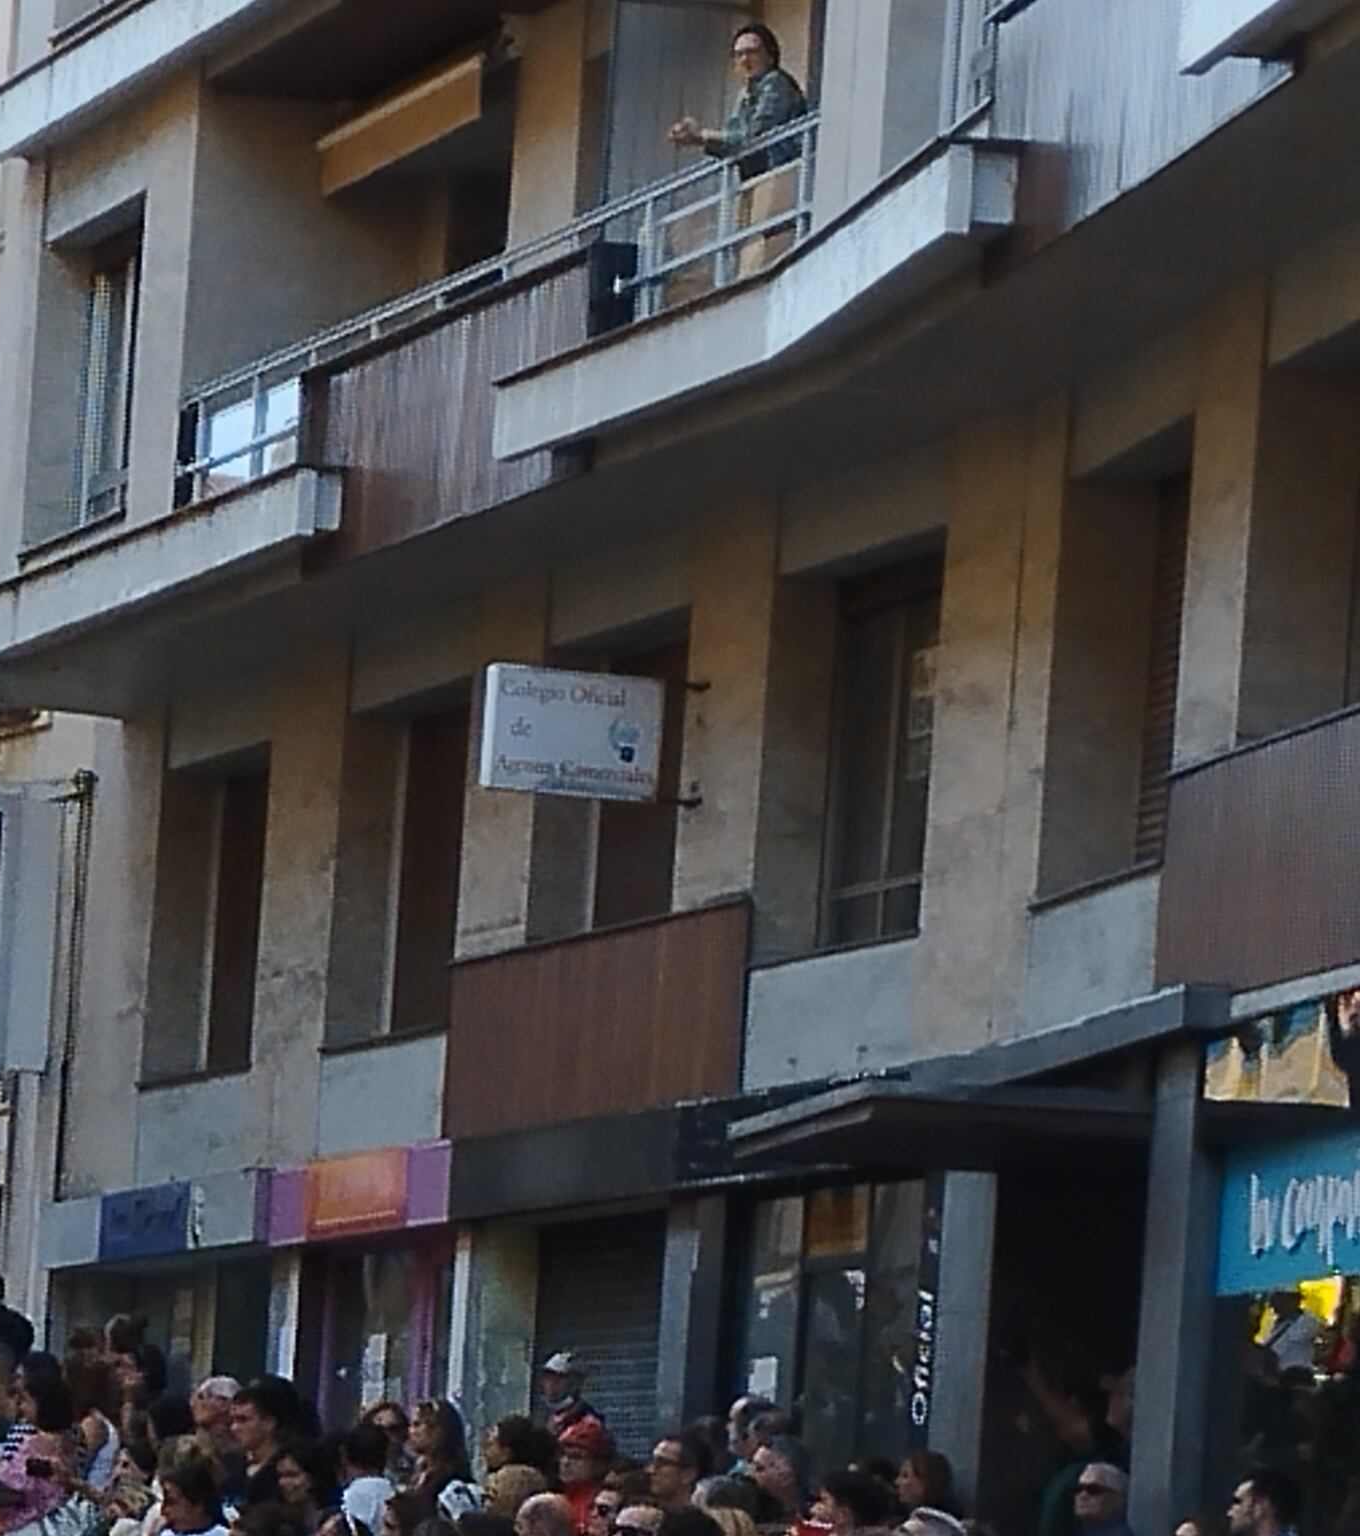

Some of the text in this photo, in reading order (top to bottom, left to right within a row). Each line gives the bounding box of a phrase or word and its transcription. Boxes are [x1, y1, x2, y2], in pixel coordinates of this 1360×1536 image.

[500, 680, 627, 707] Colegio Oficial
[509, 715, 532, 736] de
